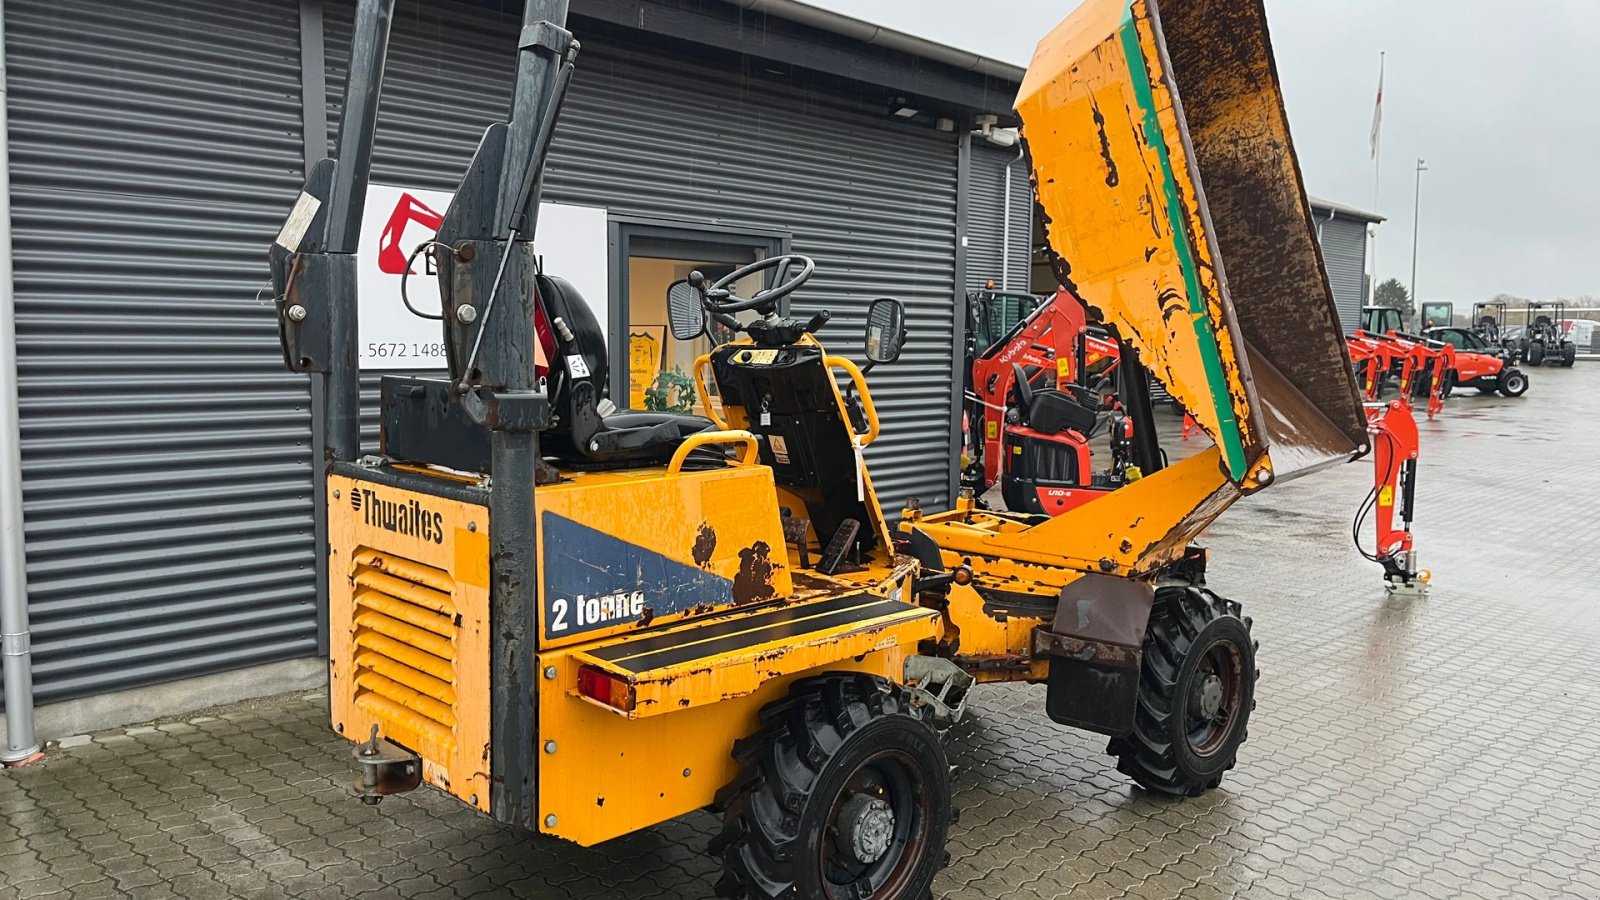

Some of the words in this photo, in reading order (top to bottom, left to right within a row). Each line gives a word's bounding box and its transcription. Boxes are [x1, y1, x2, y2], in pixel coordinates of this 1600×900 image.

[369, 344, 406, 358] 5672
[412, 344, 447, 358] 1488
[999, 340, 1027, 364] Kubota
[362, 489, 443, 544] Thwaites
[551, 599, 568, 631] 2
[577, 590, 644, 625] tonne
